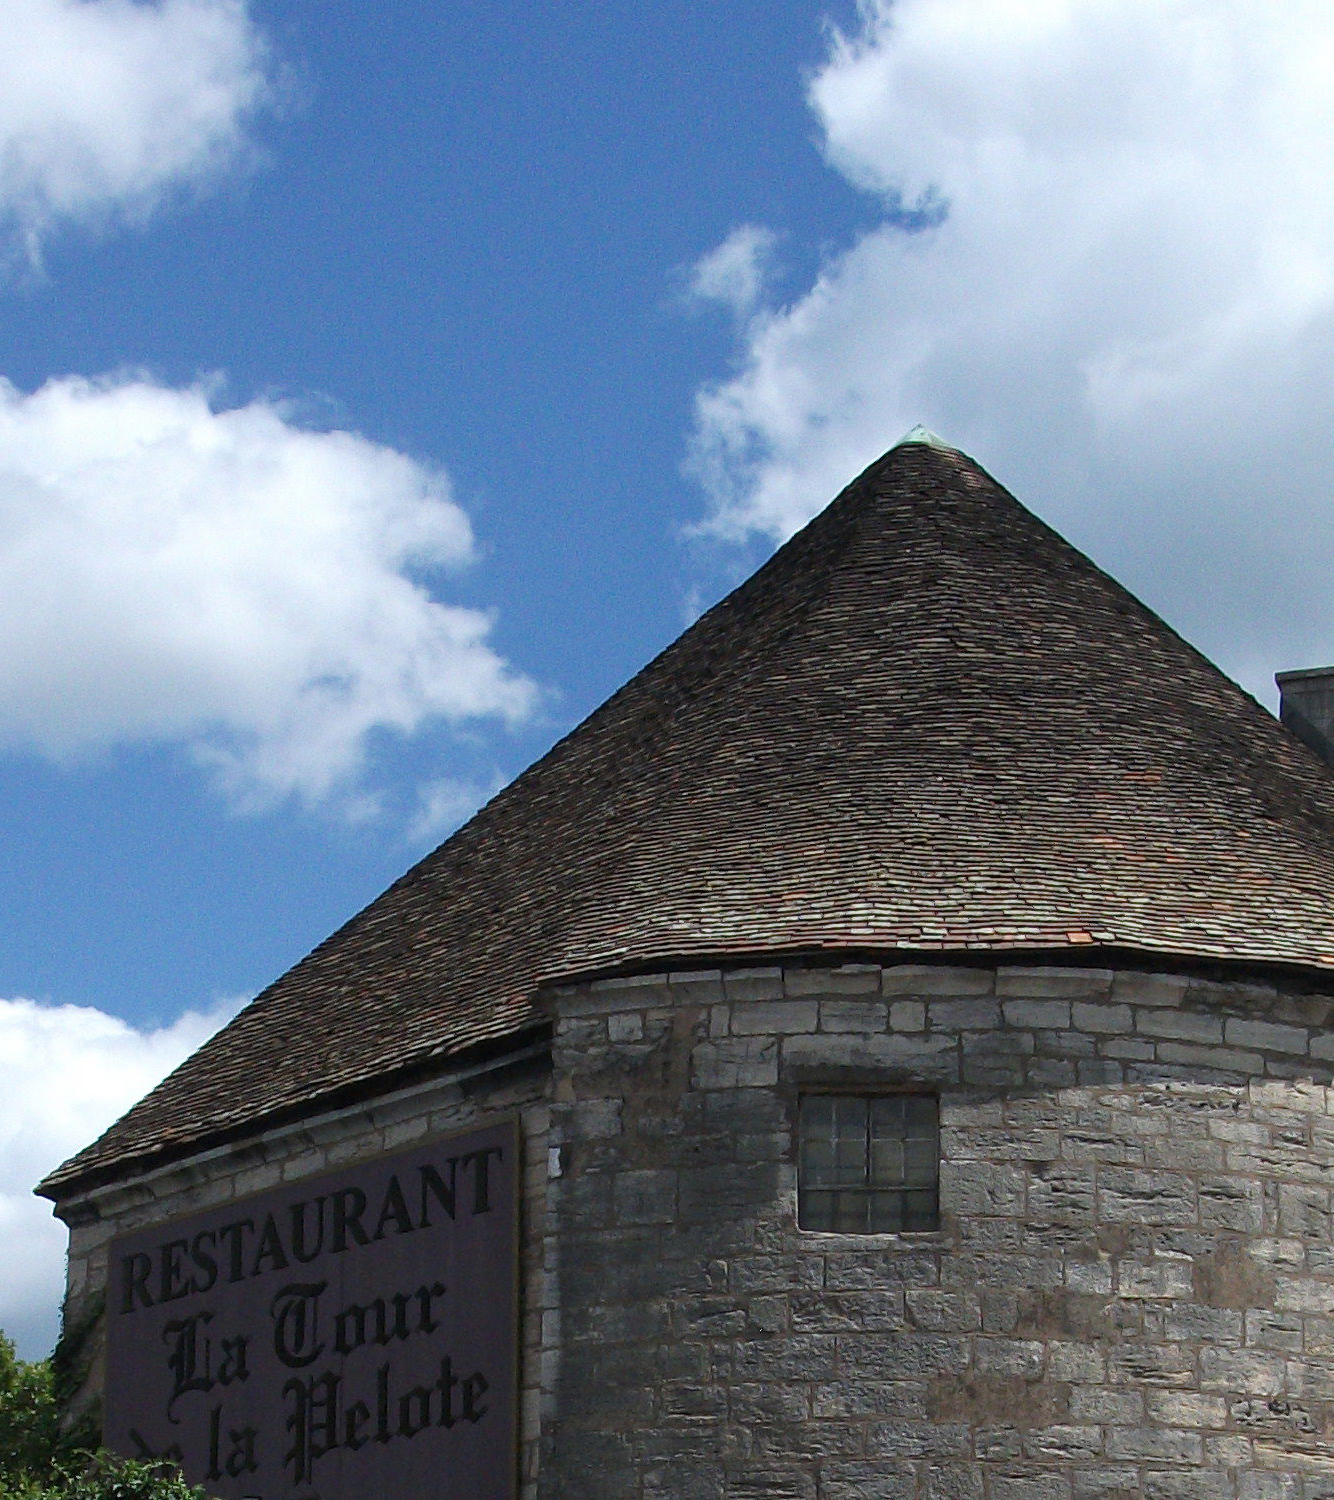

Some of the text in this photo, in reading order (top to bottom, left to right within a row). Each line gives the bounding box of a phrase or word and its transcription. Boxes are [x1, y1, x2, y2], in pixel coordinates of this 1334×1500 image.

[120, 1147, 503, 1314] RESTAURANT
[163, 1280, 447, 1424] La Tour
[205, 1404, 260, 1482] la
[281, 1355, 490, 1486] Pelote
